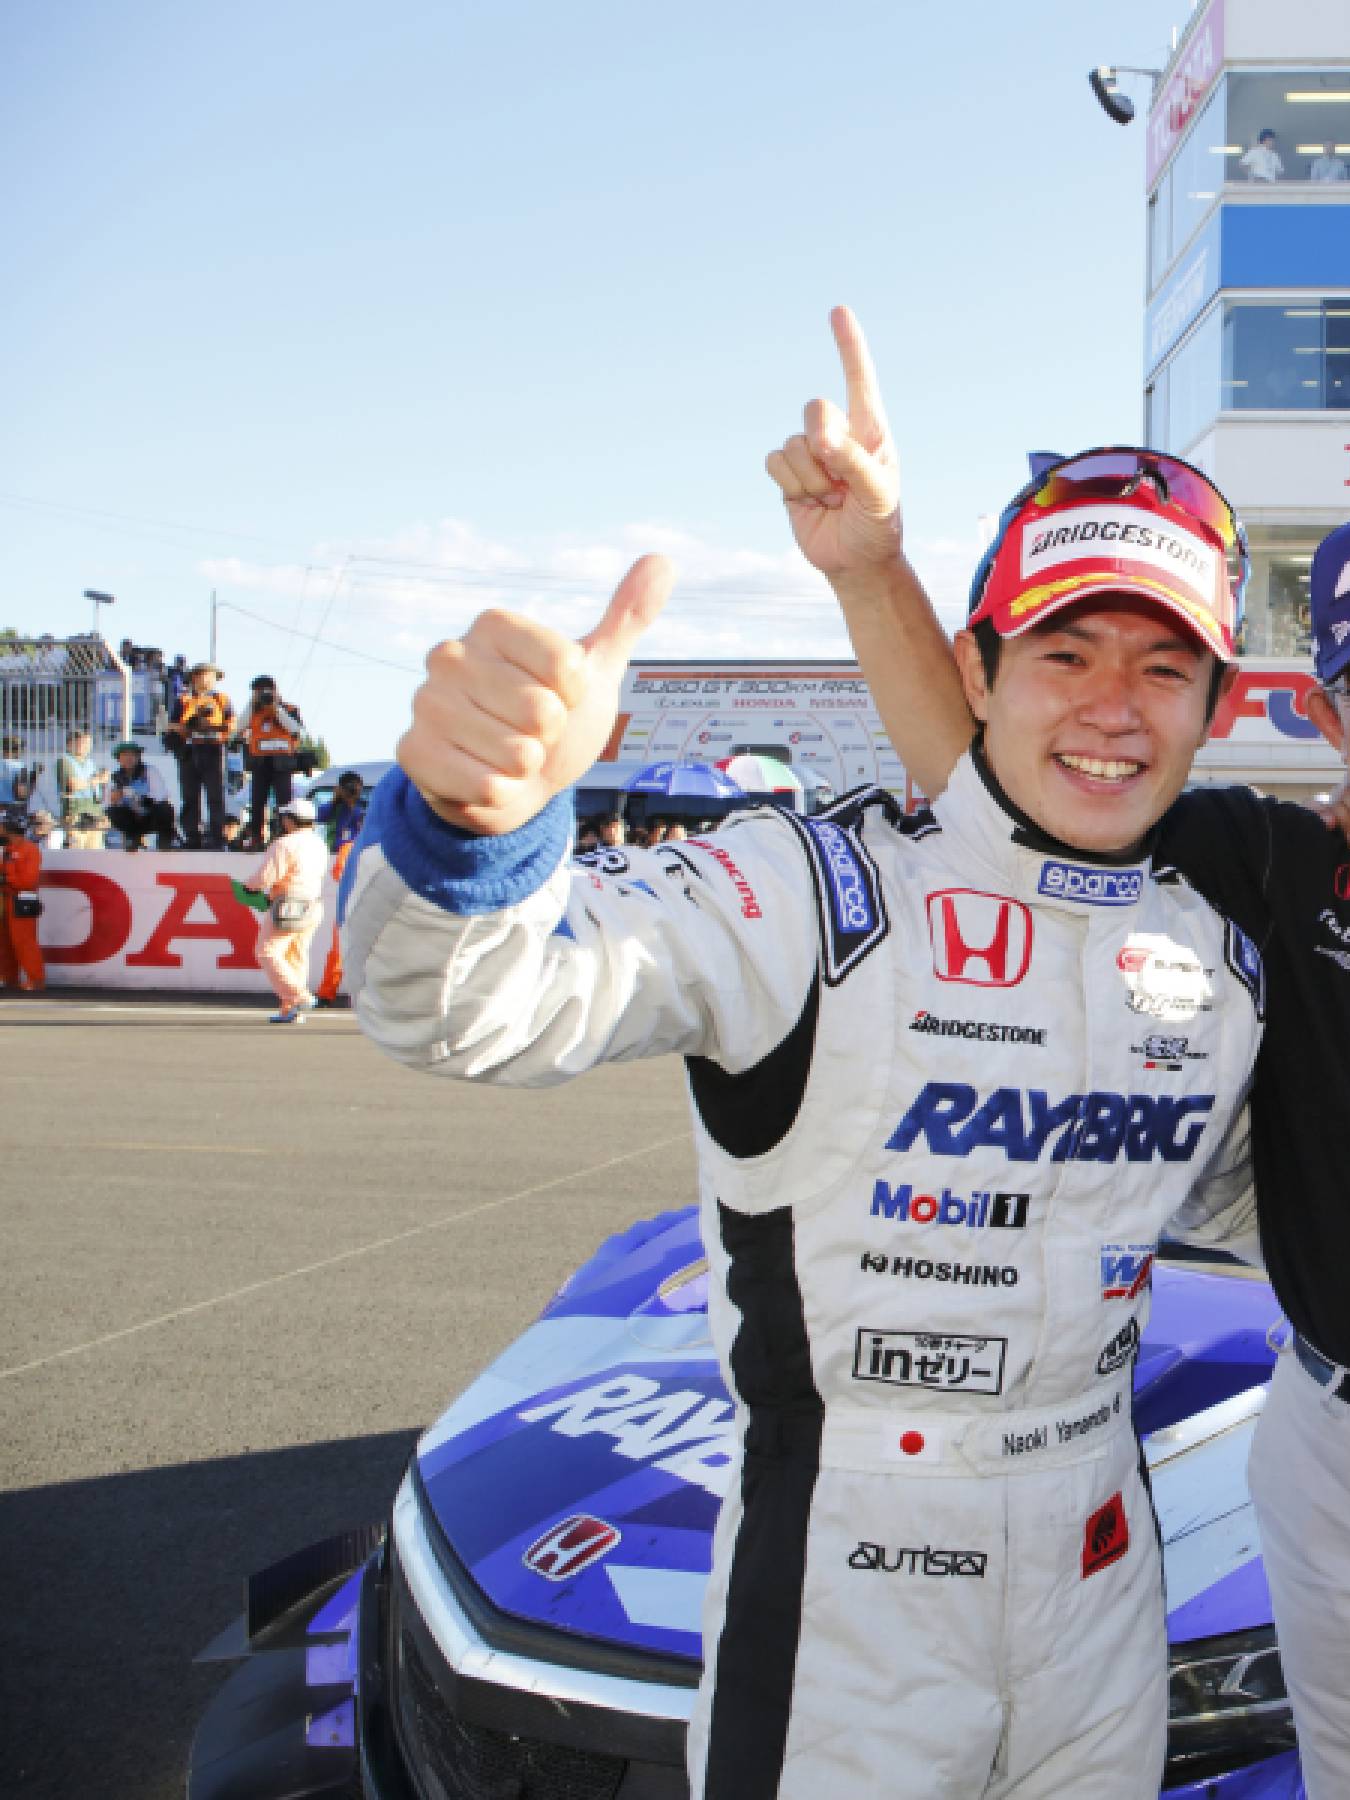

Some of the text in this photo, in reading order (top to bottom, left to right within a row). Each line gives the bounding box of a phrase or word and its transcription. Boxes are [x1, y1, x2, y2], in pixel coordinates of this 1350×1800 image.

[633, 680, 699, 694] SUGO
[702, 680, 738, 694] GT
[819, 680, 868, 694] RAC
[732, 699, 795, 708] HONDA
[809, 699, 868, 708] NISSAN
[1042, 864, 1140, 904] sparco
[909, 1011, 1047, 1047] BRIDGESTONE
[885, 1082, 1215, 1163] RAYBRIG
[870, 1179, 989, 1228] Mobil
[894, 1256, 1019, 1288] HOSHINO
[517, 1373, 736, 1499] RAYB
[1002, 1424, 1048, 1456] Naoki
